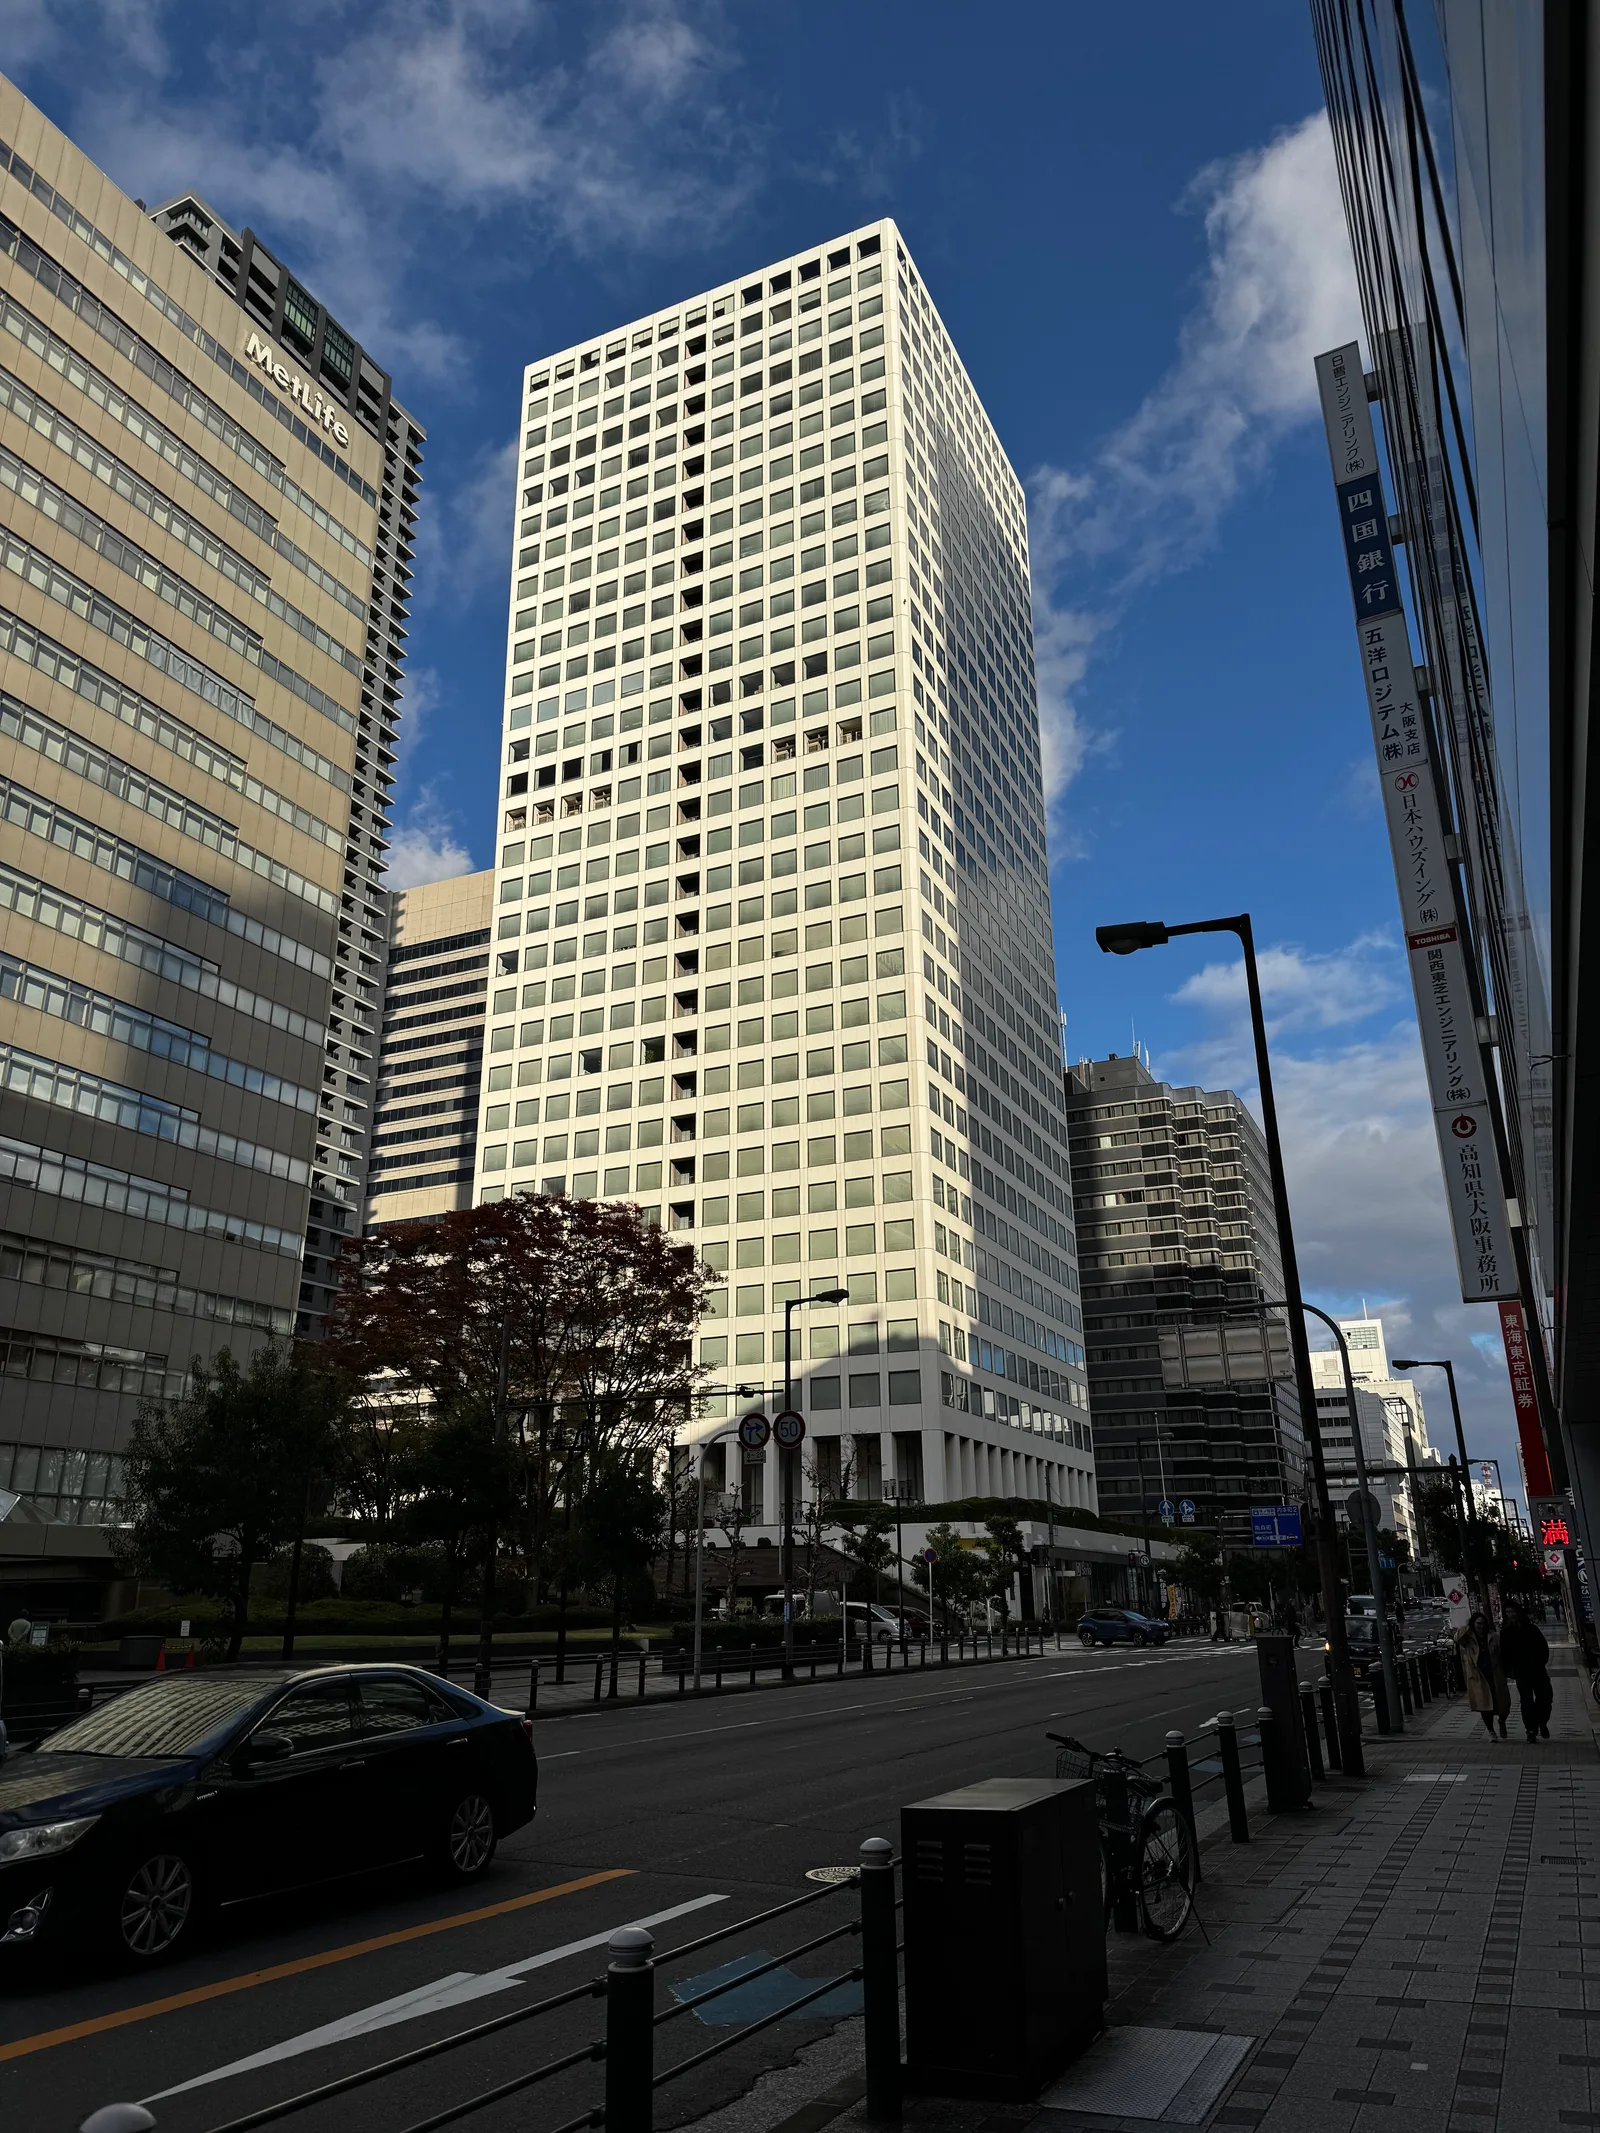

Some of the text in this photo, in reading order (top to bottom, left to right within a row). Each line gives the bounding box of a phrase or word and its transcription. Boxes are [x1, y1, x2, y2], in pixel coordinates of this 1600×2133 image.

[244, 331, 349, 448] MetLife
[1347, 489, 1390, 605] 四国銀行
[1399, 701, 1421, 756] 大阪支店
[1414, 931, 1451, 946] TOSHIBA
[1427, 948, 1471, 1102] 関西東芝エンジニアリング(株)
[1458, 1144, 1500, 1293] 高知県大阪事務所
[1503, 1313, 1534, 1409] 東海東京証券
[780, 1421, 798, 1437] 50
[1540, 1518, 1570, 1546] 満
